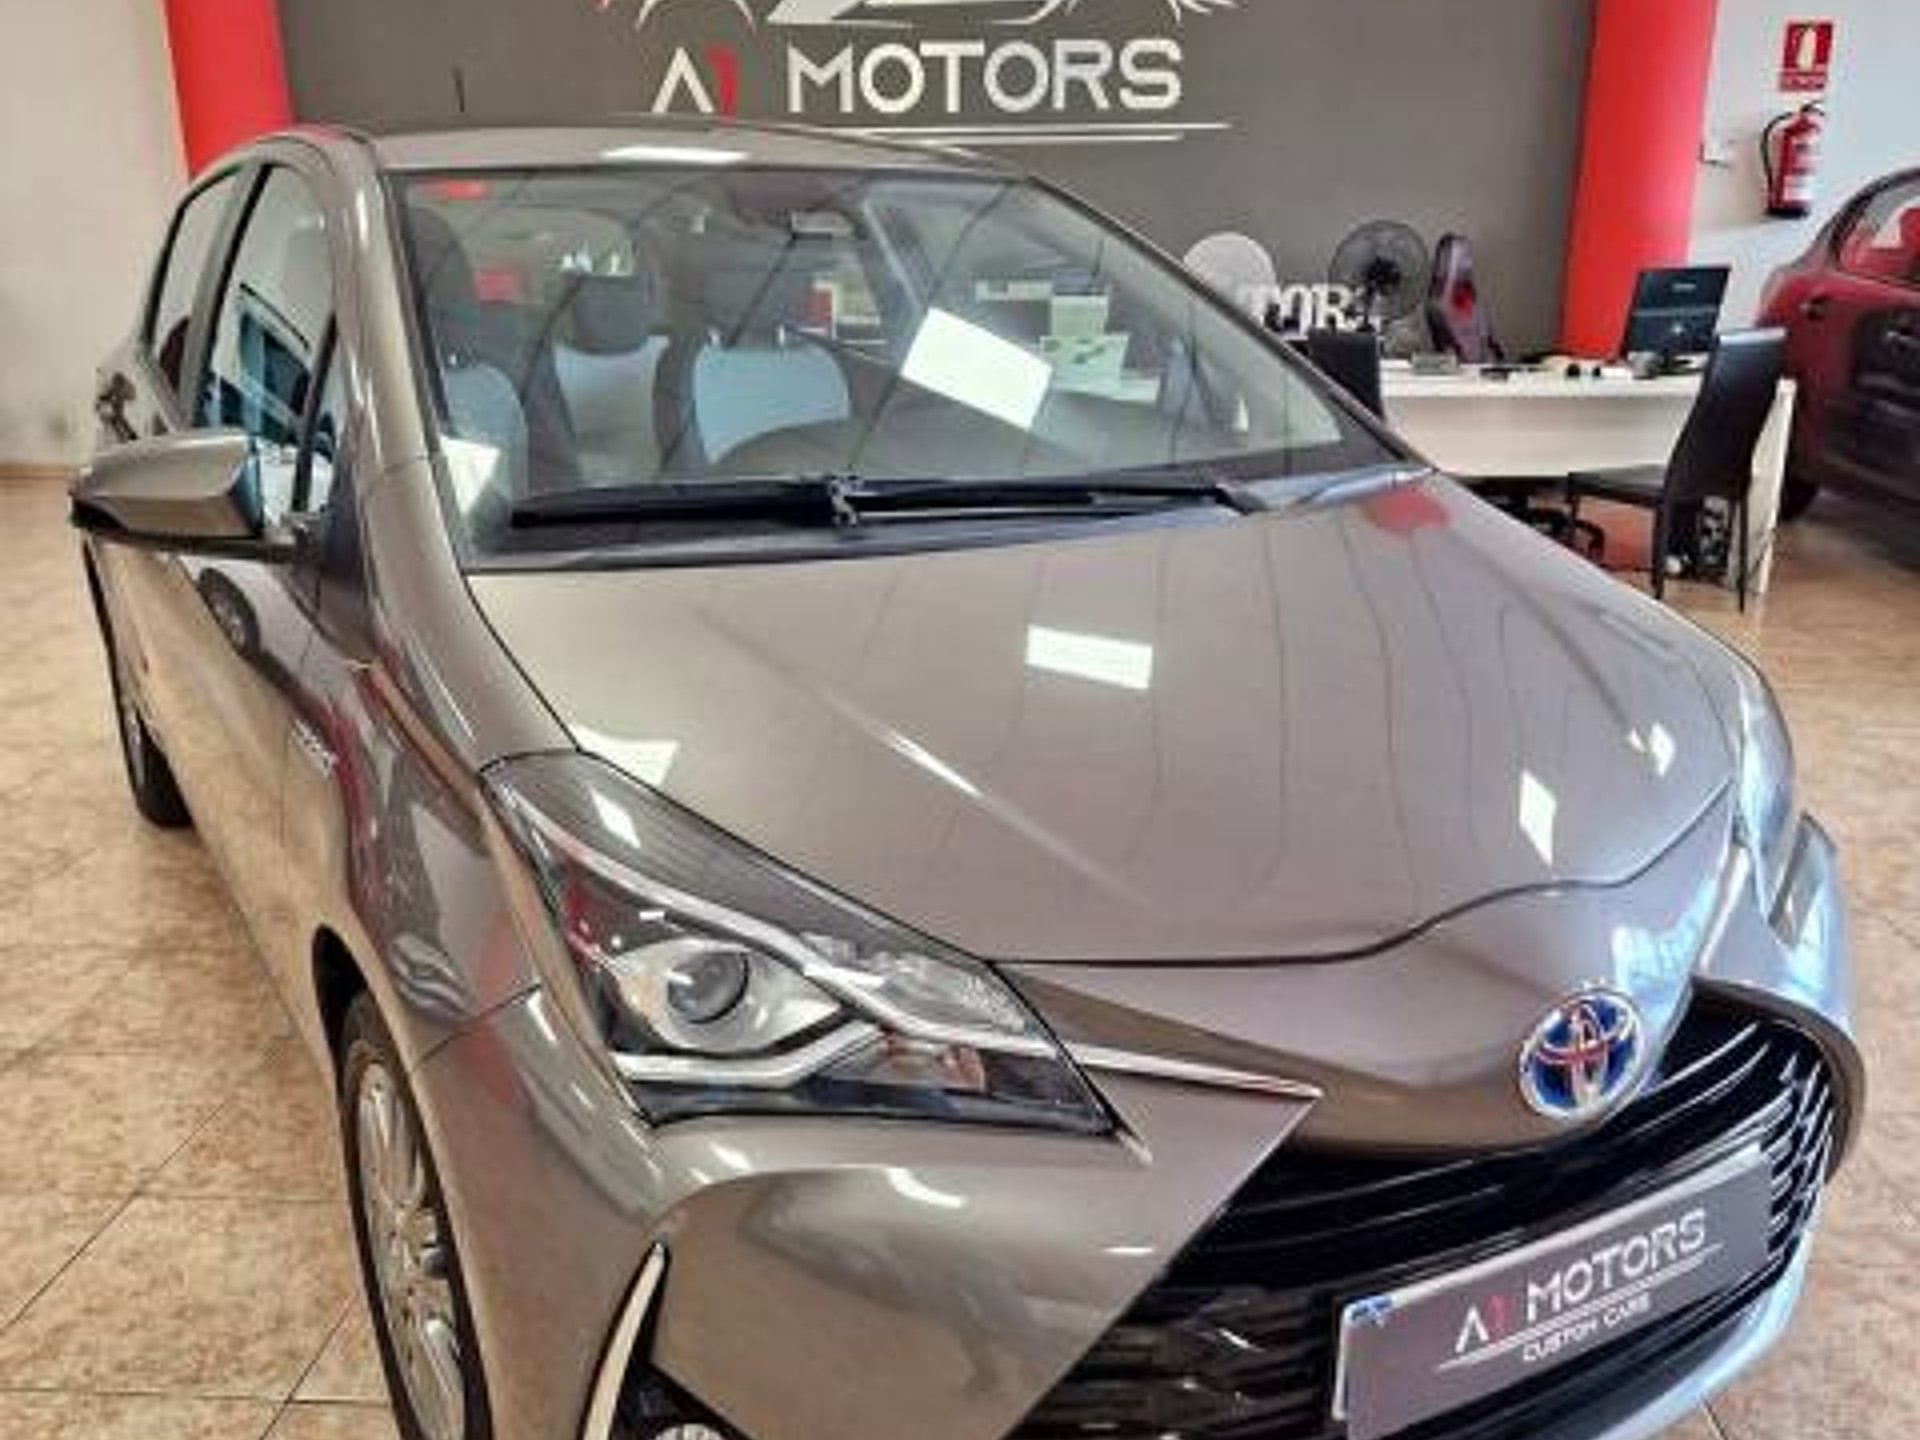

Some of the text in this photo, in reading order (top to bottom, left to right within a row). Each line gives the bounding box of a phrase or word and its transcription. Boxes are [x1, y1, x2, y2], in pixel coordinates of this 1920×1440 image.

[651, 39, 1183, 123] A1 MOTORS
[1527, 1210, 1706, 1321] MOTORS
